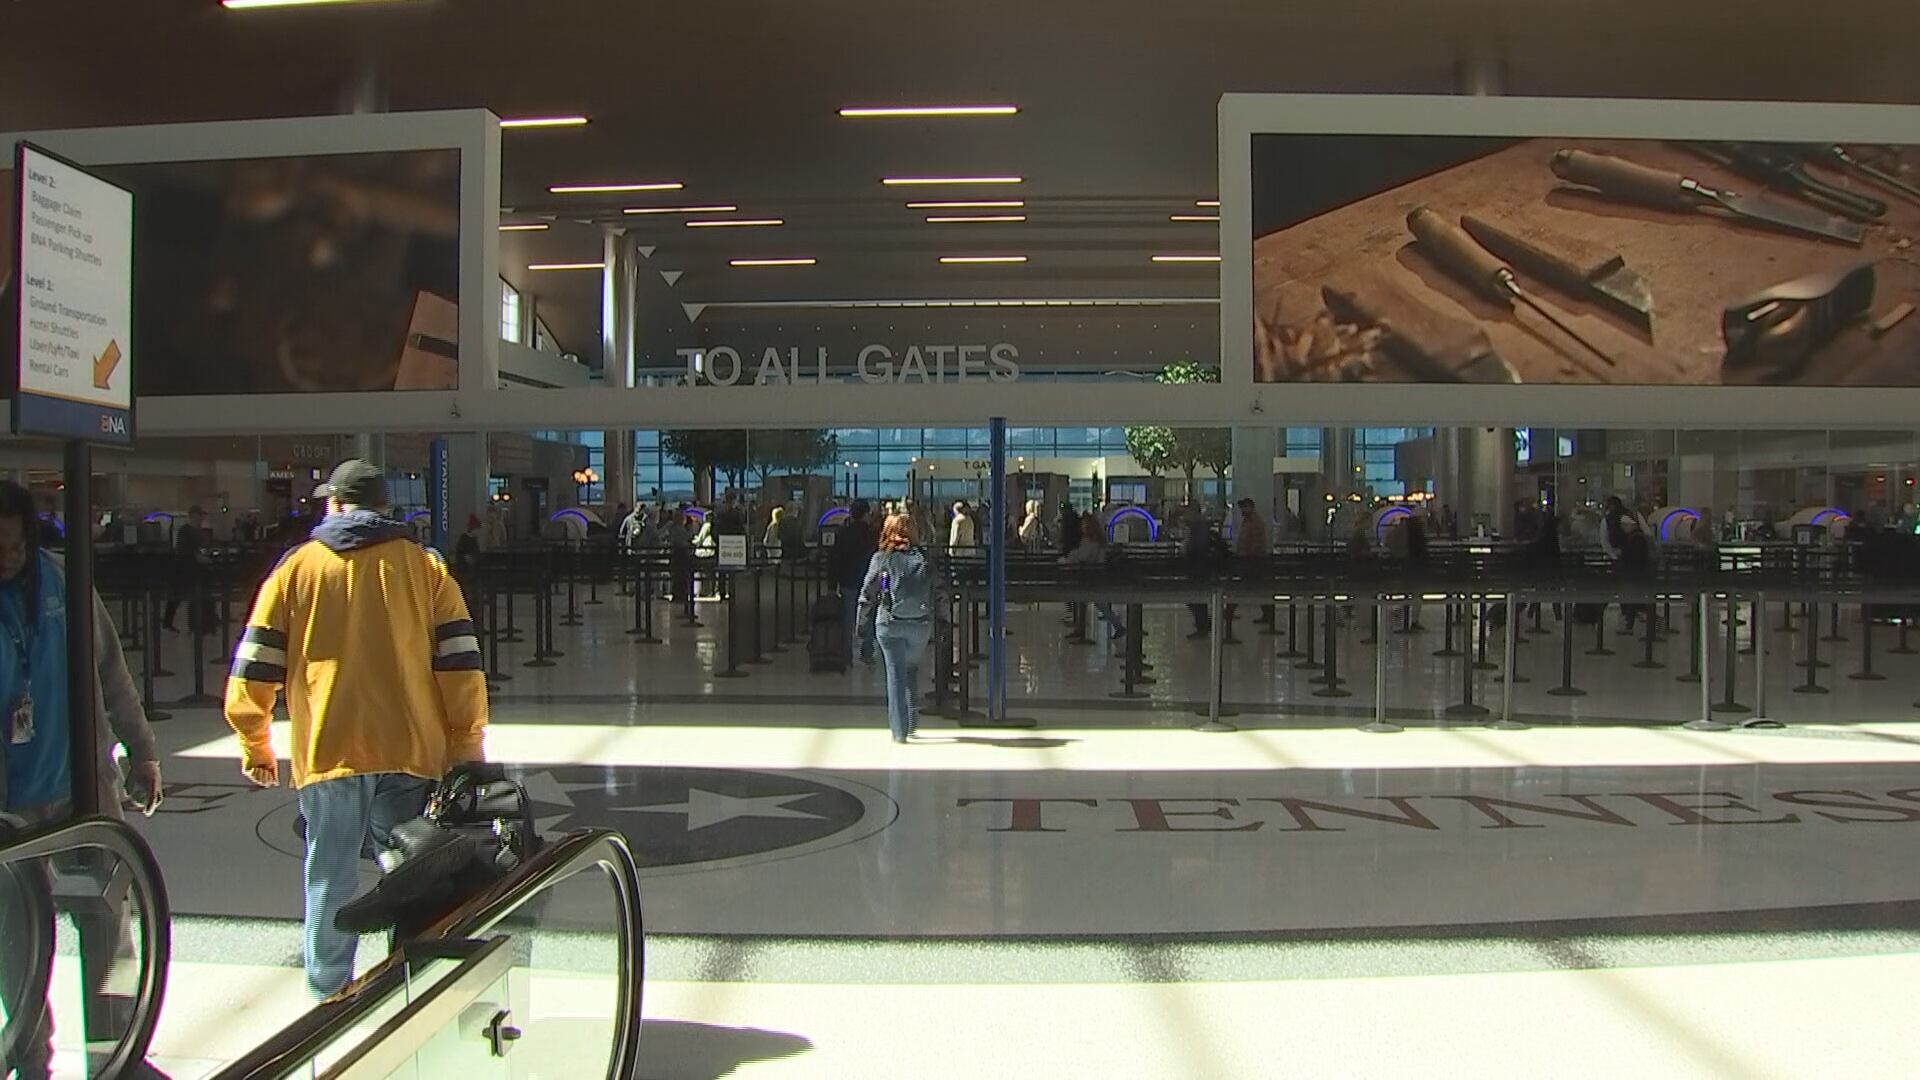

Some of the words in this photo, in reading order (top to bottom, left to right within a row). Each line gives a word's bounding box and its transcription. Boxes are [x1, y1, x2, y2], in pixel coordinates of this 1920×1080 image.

[28, 168, 48, 185] Level
[31, 190, 61, 213] Baggage
[62, 202, 82, 219] Claim
[31, 211, 66, 234] Passenger
[31, 232, 47, 247] BNA
[48, 238, 73, 260] Parking
[74, 247, 102, 266] Shuttles
[26, 274, 46, 290] Level
[30, 296, 57, 314] Ground
[58, 303, 107, 326] Transportation
[30, 319, 49, 332] Hotel
[51, 321, 79, 339] Shuttles
[29, 360, 50, 374] Rental
[54, 364, 69, 378] Cars
[676, 346, 742, 386] TO
[754, 346, 844, 385] ALL
[856, 344, 1021, 385] GATES
[102, 415, 126, 434] BNA
[957, 788, 1920, 833] TENNES
